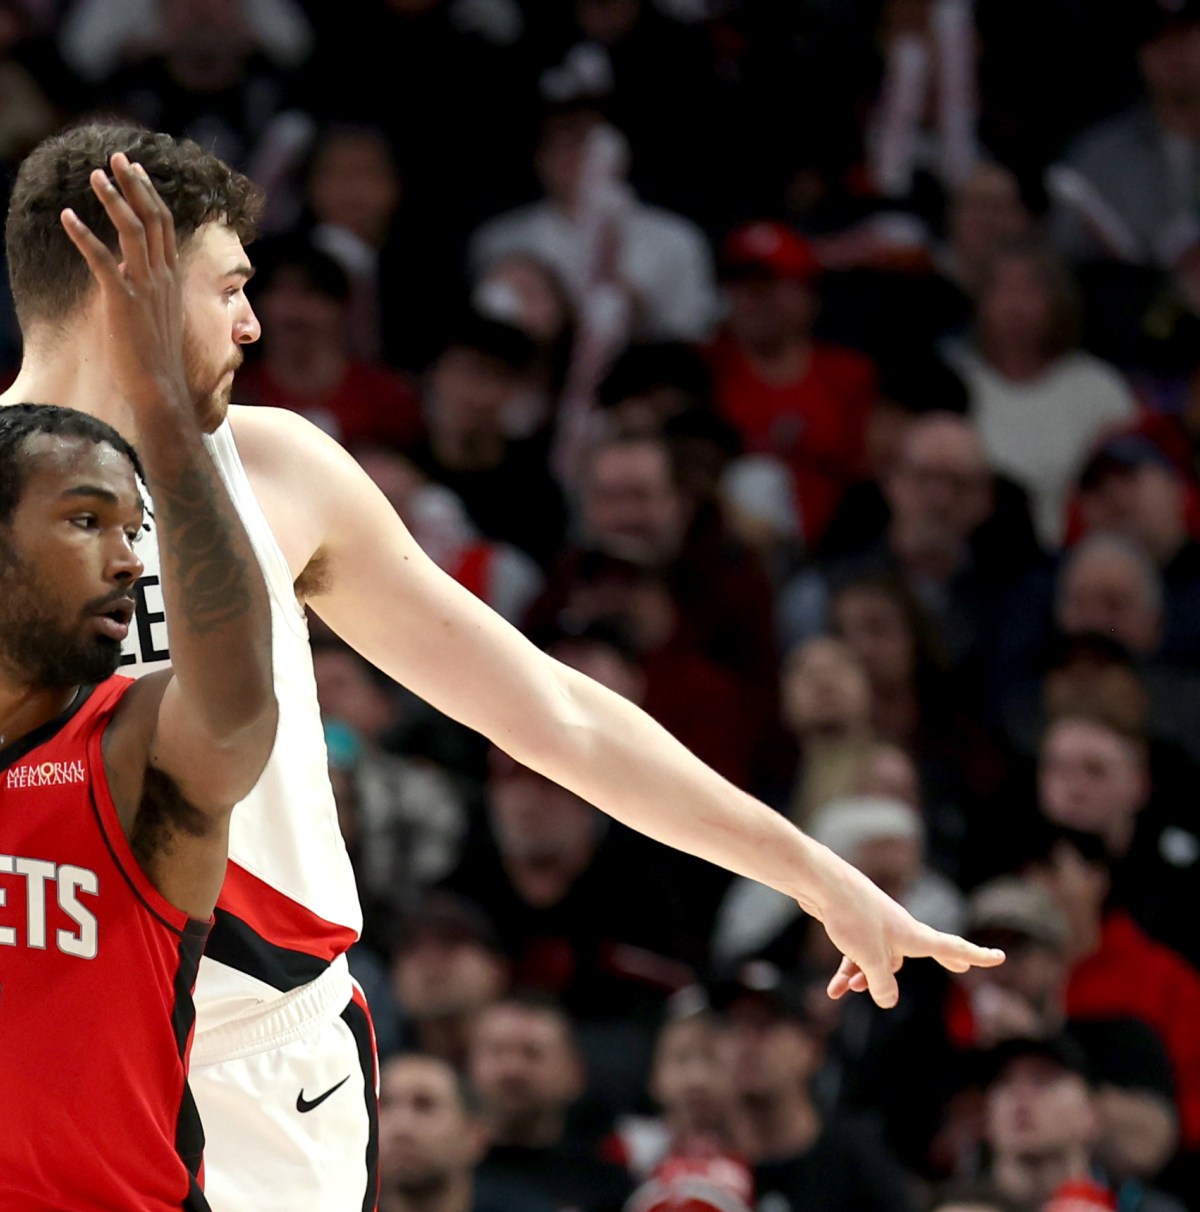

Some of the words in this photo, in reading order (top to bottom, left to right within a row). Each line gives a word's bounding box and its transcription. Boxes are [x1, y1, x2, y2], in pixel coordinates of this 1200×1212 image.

[120, 575, 170, 666] E
[7, 760, 85, 780] MEMORIAL
[7, 769, 84, 788] HERMANN
